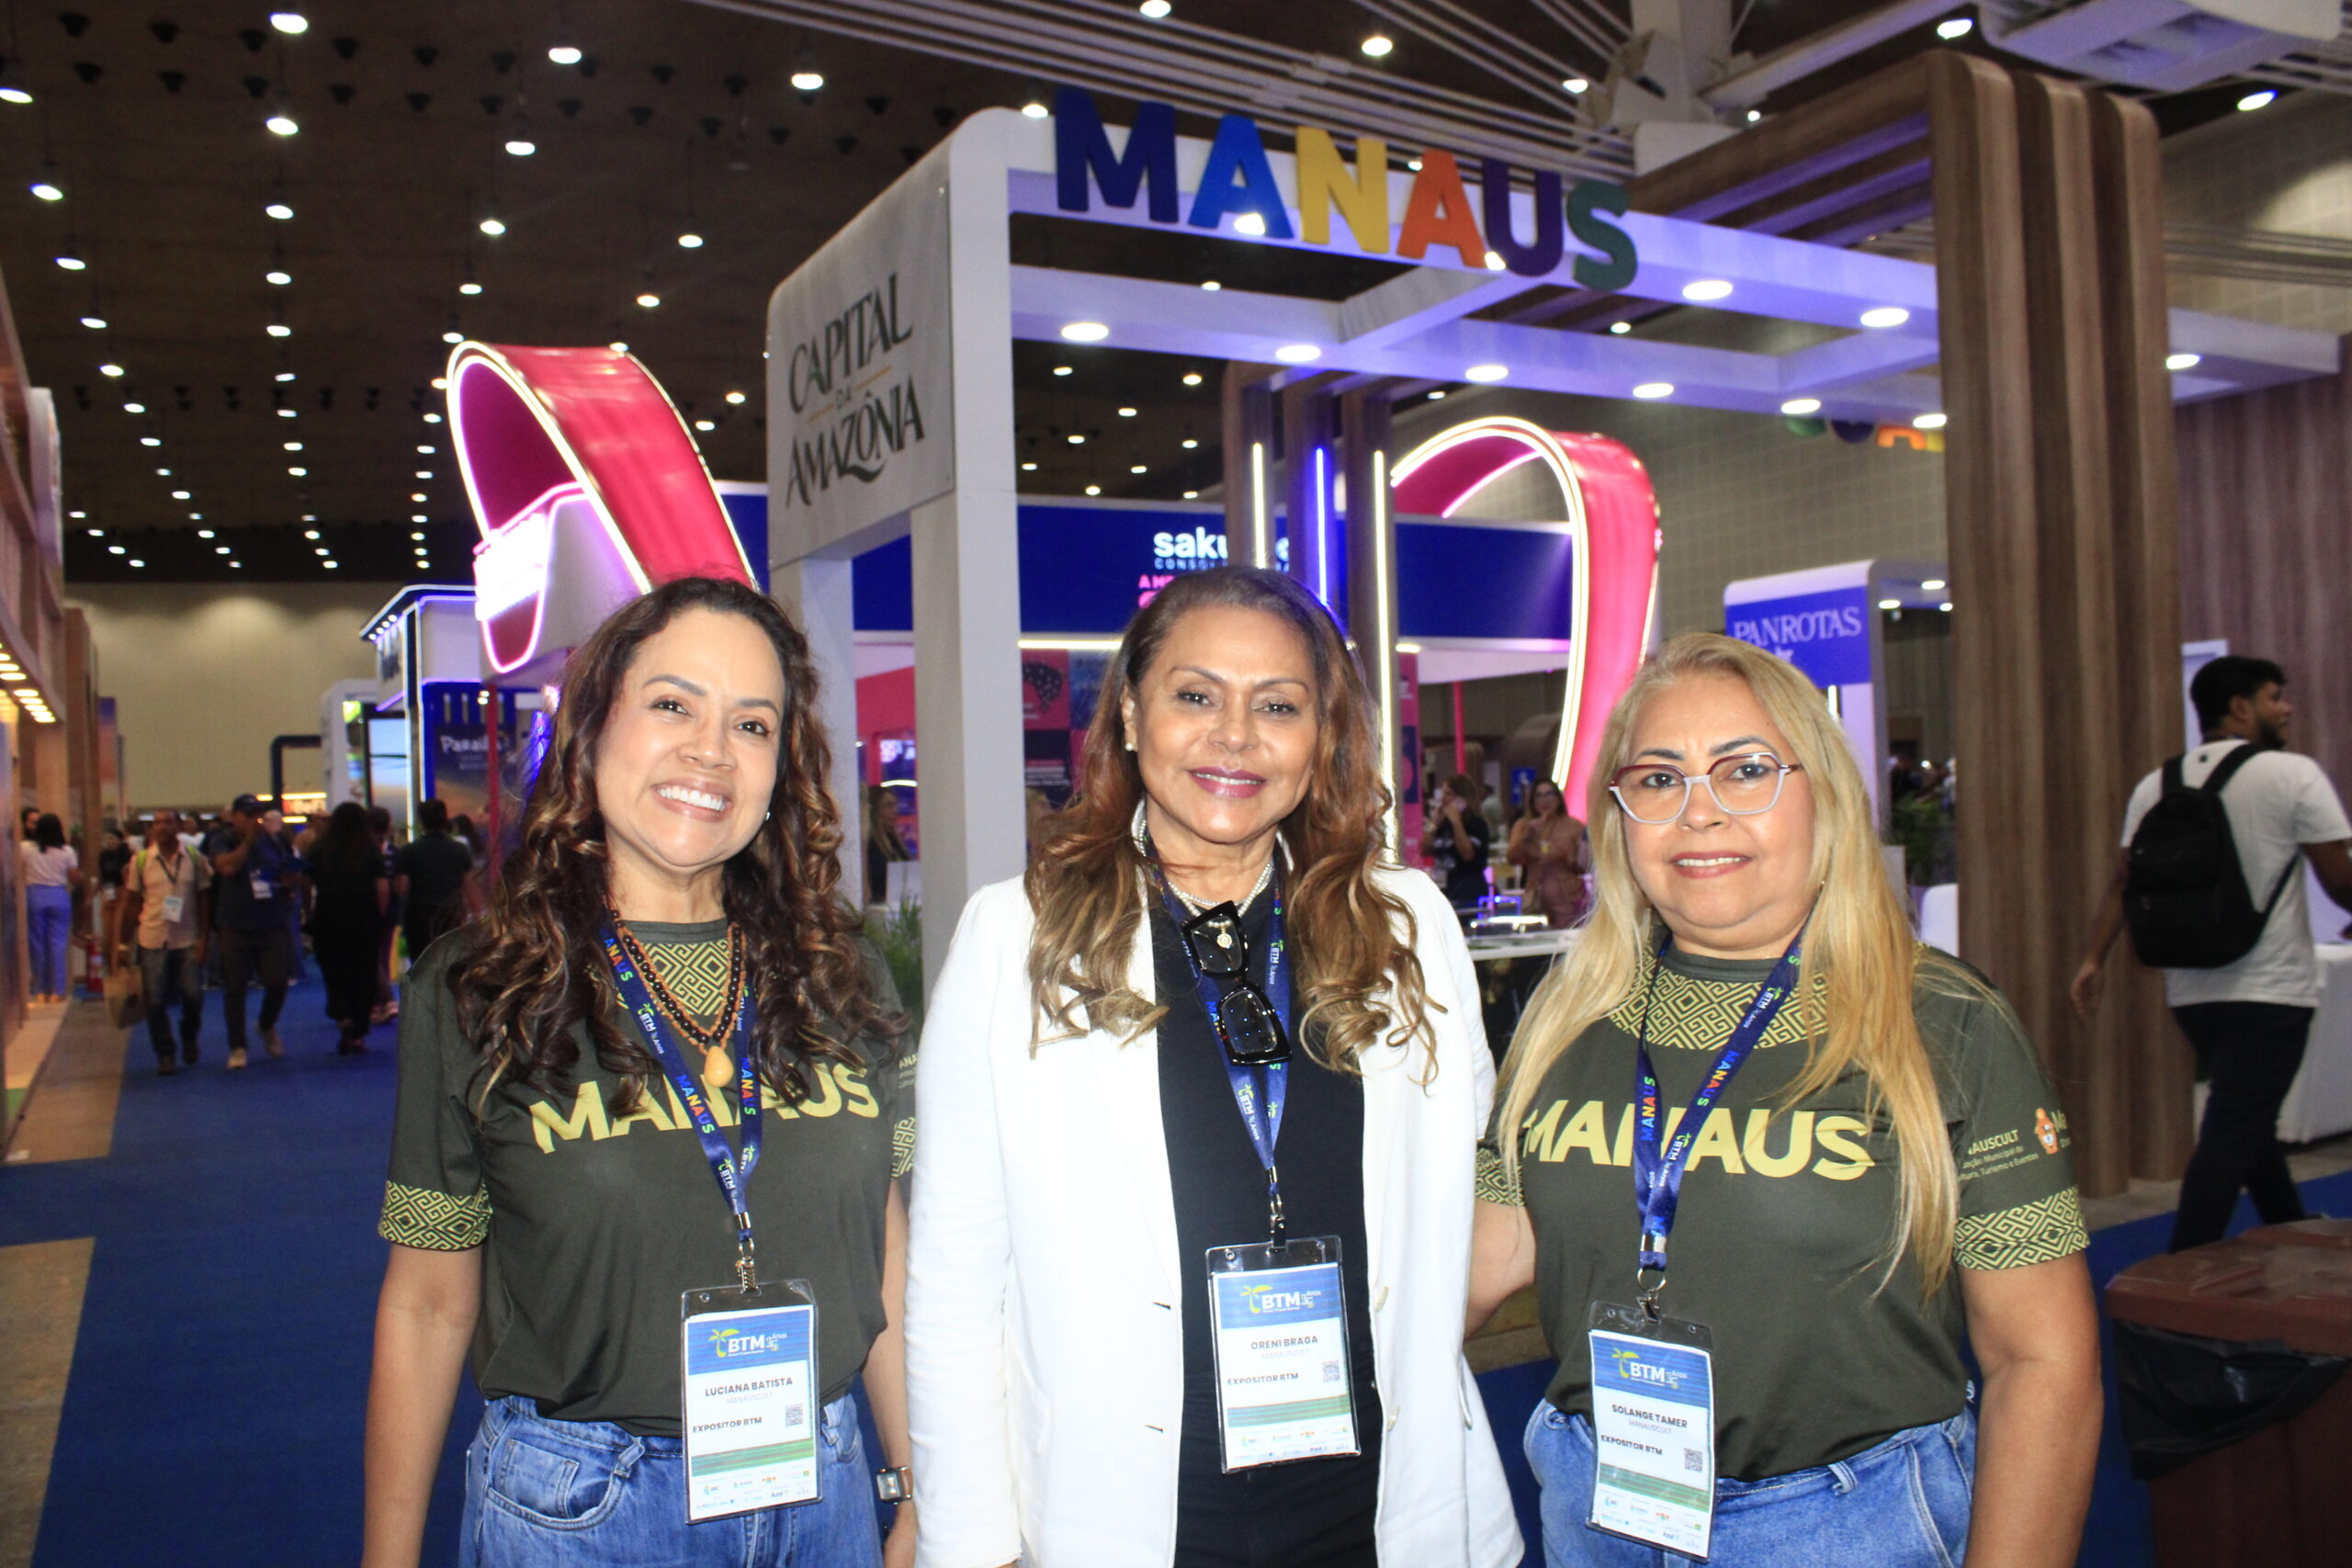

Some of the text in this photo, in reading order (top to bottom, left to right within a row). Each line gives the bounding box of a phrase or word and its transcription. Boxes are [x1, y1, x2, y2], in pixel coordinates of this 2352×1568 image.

[1054, 89, 1638, 291] MANAUS
[788, 274, 912, 413] CAPITAL
[1733, 606, 1862, 647] PANROTAS
[602, 931, 634, 982] ANAUS
[1757, 991, 1775, 1010] BTM
[640, 1012, 657, 1032] BTM
[741, 1057, 757, 1116] MANAUS
[1697, 1050, 1740, 1107] MANAUS
[675, 1074, 715, 1134] MANAUS
[1240, 1094, 1255, 1116] BTM
[1640, 1076, 1657, 1142] MANAUS
[1668, 1140, 1684, 1161] BTM
[719, 1168, 736, 1190] BTM
[1261, 1292, 1301, 1310] BTM
[728, 1335, 765, 1353] BTM
[1250, 1336, 1318, 1350] ORENI BRAGA
[1227, 1372, 1299, 1386] EXPOSITOR BTM
[1630, 1361, 1666, 1383] BTM
[706, 1377, 794, 1397] LUCIANA BATISTA
[693, 1416, 763, 1433] EXPOSITOR BTM
[1611, 1404, 1688, 1429] SOLANGE TAMER
[1600, 1435, 1663, 1456] EXPOSITOR BTM
